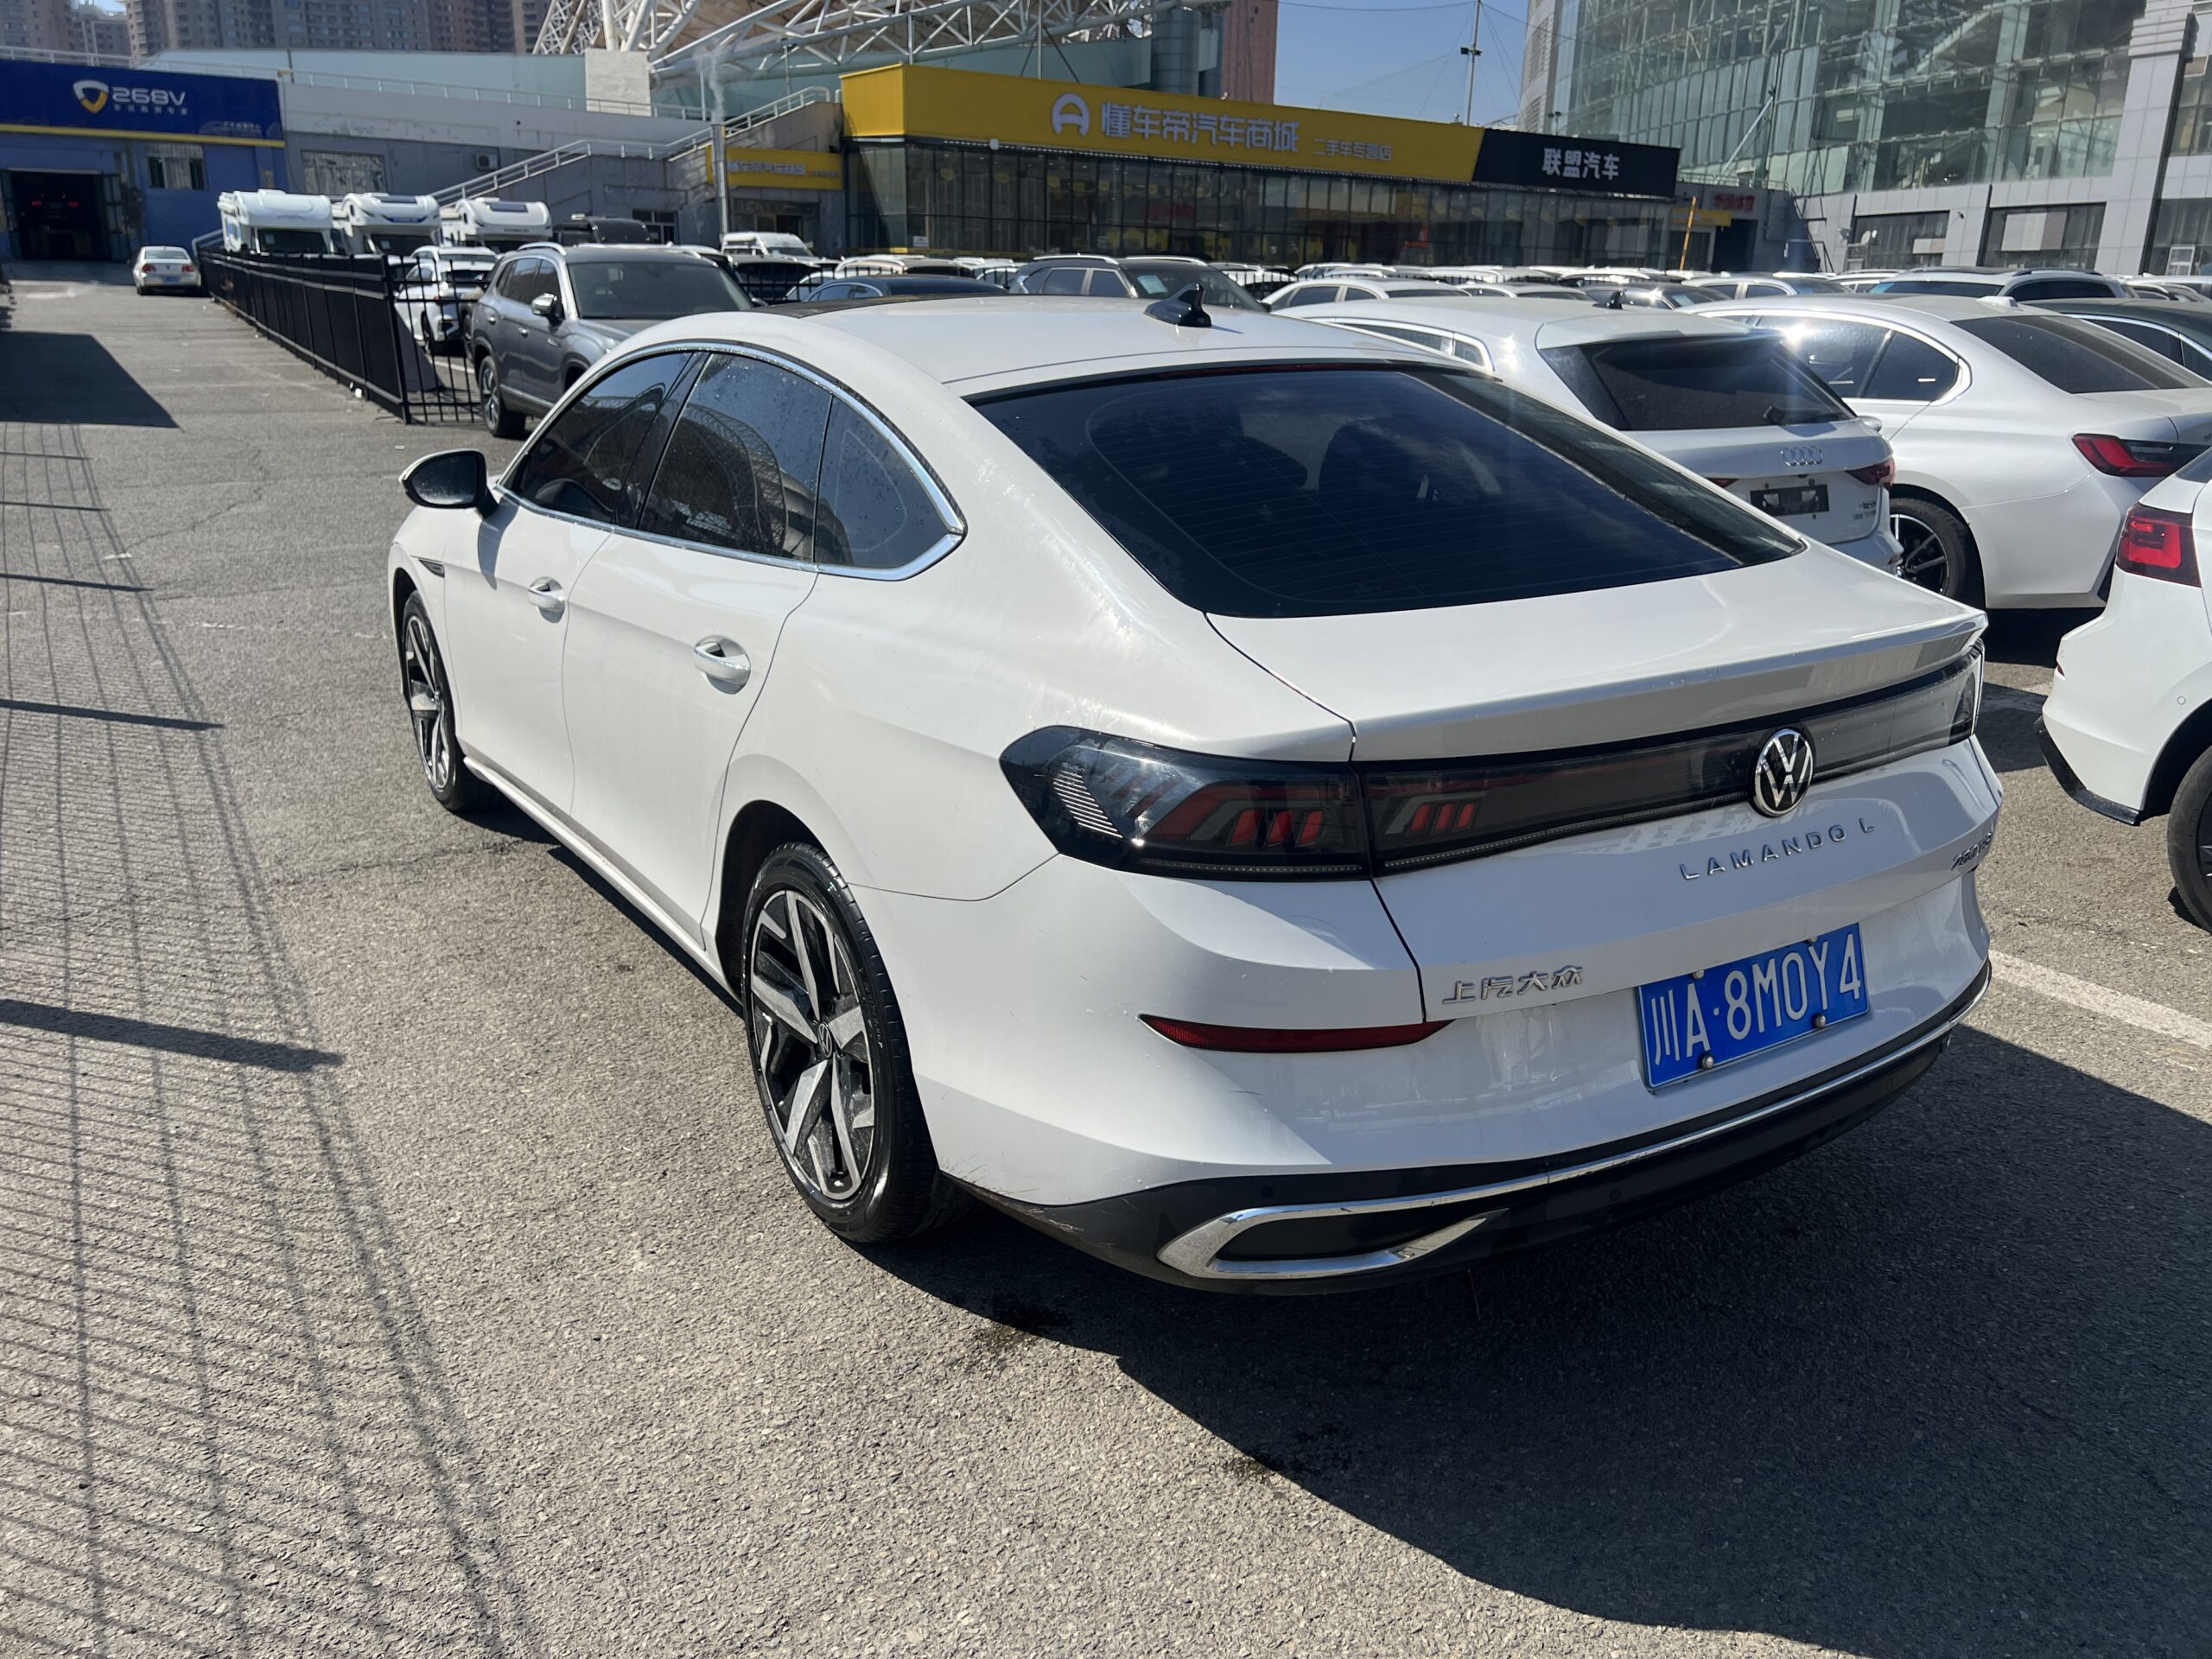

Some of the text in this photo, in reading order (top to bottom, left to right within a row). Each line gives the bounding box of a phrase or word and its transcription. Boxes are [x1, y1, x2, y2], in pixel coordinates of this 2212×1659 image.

[112, 87, 186, 106] 268V
[1101, 101, 1300, 153] 懂车帝汽车商城
[1541, 148, 1620, 181] 联盟汽车
[1679, 817, 1875, 880] LAMANDO L
[1442, 964, 1583, 1004] 上汽大众
